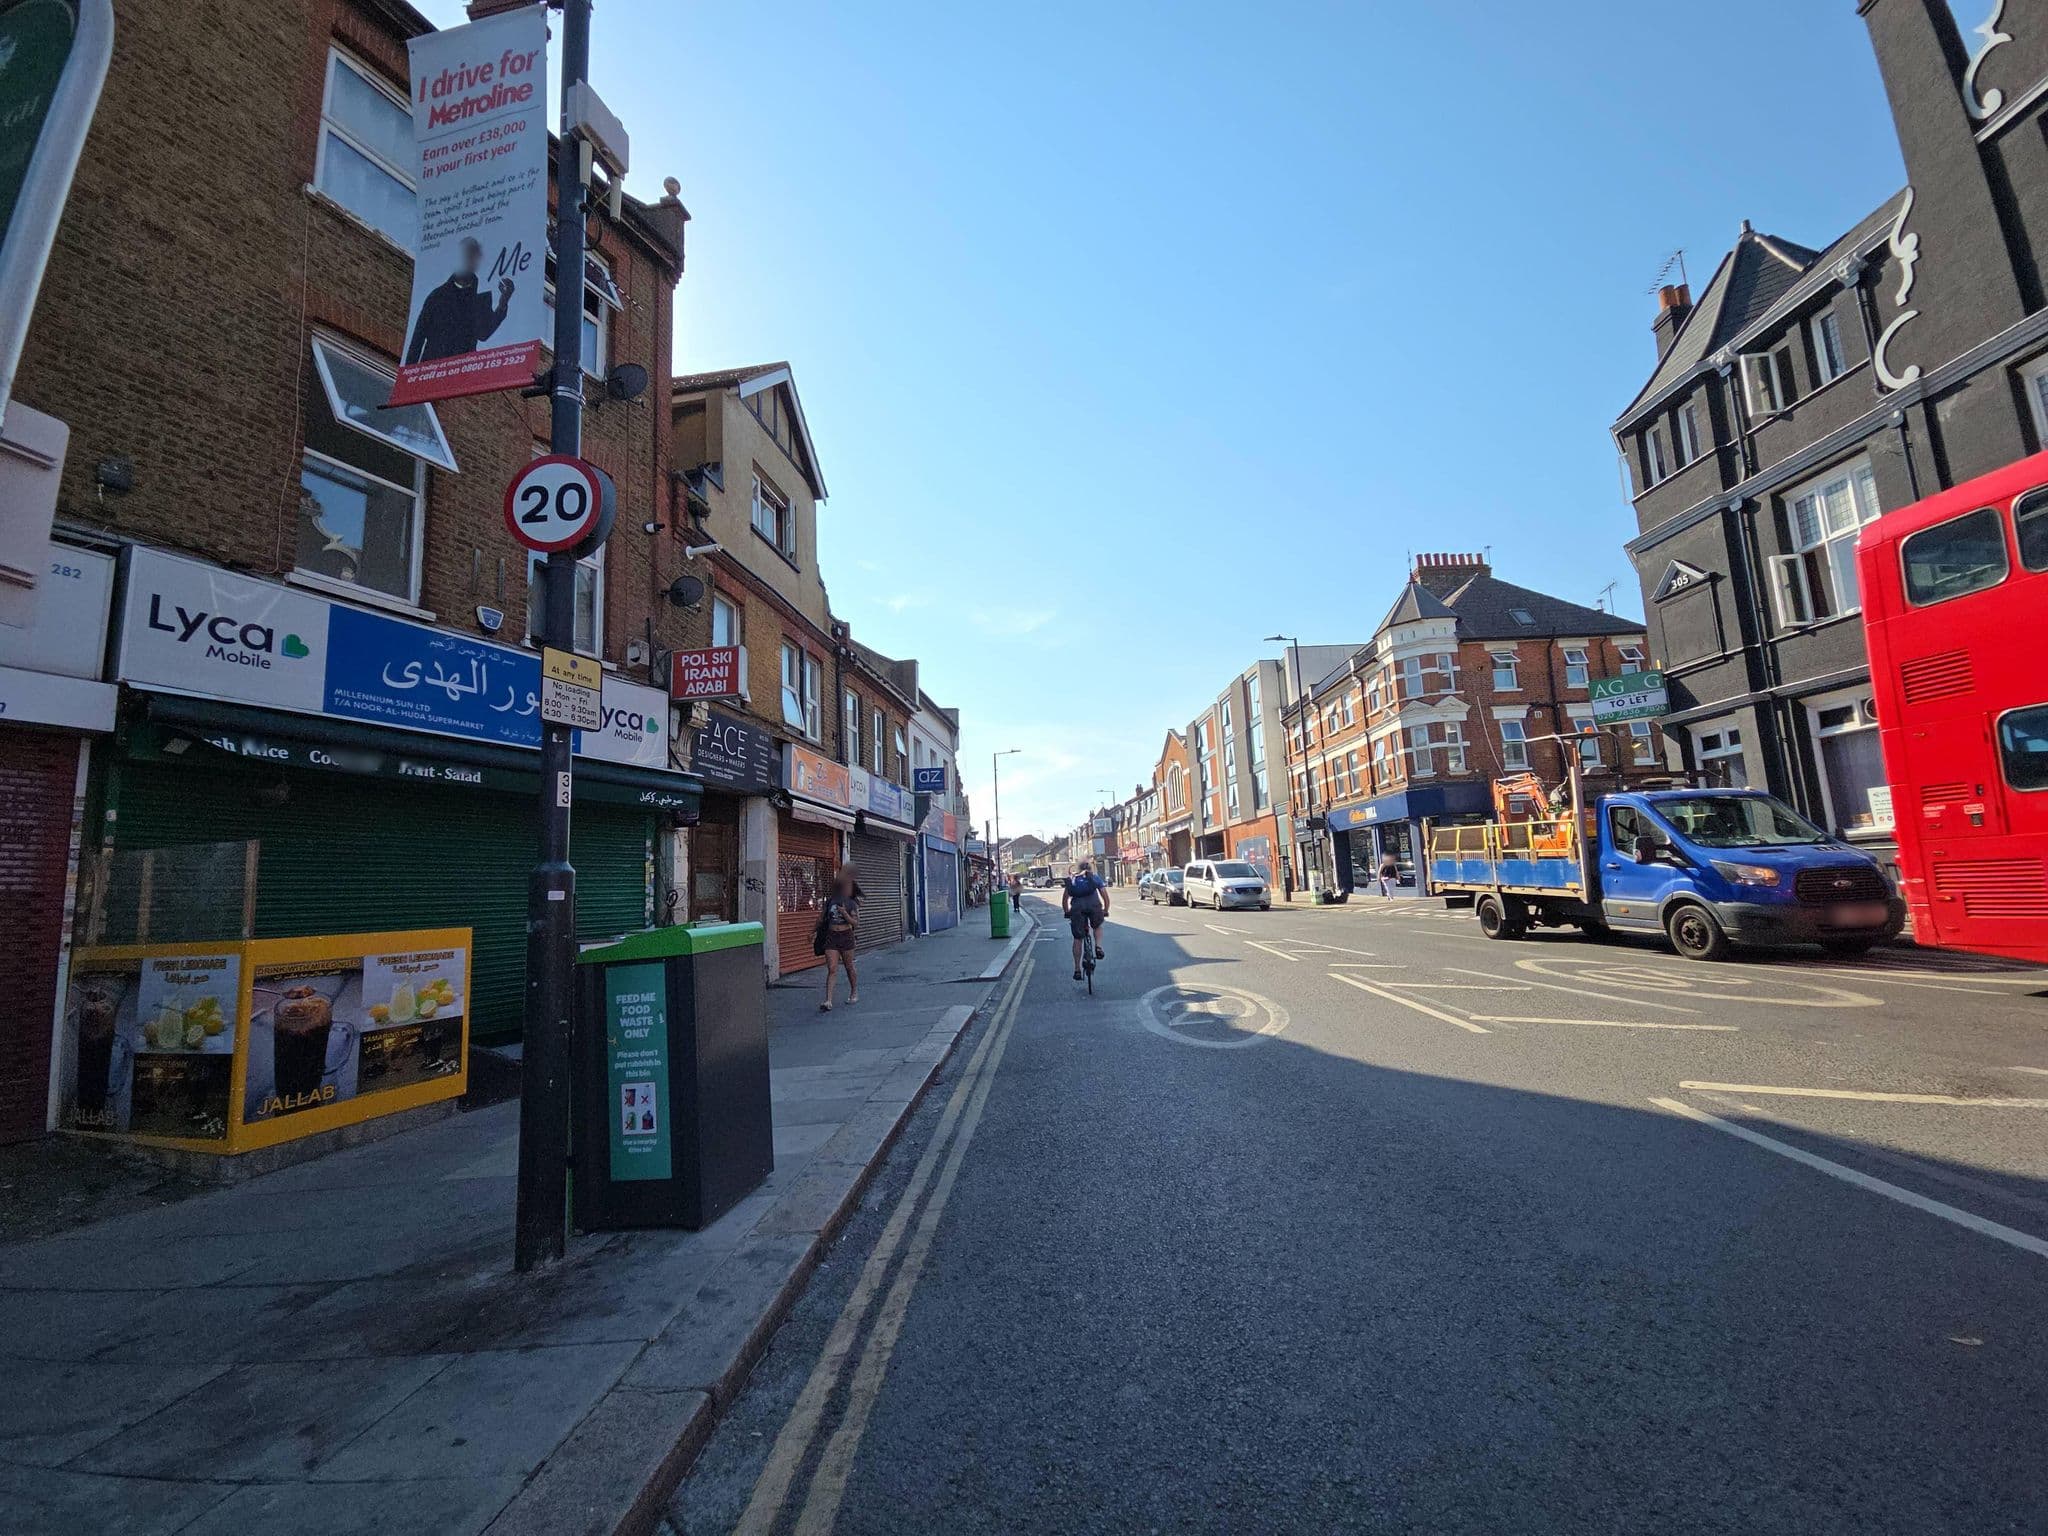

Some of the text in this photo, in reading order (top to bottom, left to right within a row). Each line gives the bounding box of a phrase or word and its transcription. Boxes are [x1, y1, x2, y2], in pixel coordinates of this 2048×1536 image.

[419, 49, 540, 102] I drive for
[428, 82, 534, 130] Metroline
[422, 120, 526, 161] Earn over £38,000
[422, 142, 518, 180] in your first year
[487, 240, 532, 282] Me
[407, 376, 418, 384] or
[418, 371, 436, 382] call
[436, 370, 446, 378] us
[448, 368, 460, 376] on
[461, 362, 484, 374] 0800
[502, 354, 526, 366] 2929
[521, 482, 587, 524] 20
[52, 564, 82, 579] 282
[1671, 574, 1688, 589] 305
[149, 594, 274, 653] Lyca
[206, 645, 272, 670] Mobile
[682, 650, 732, 667] POL SKI
[382, 658, 488, 702] الهدى
[551, 666, 592, 683] At any time
[684, 665, 729, 680] IRANI
[552, 681, 590, 698] No loading
[685, 680, 728, 694] ARABI
[334, 688, 430, 712] MILLENNIUM SUN LTD
[555, 692, 570, 702] Mon
[579, 697, 588, 706] Fri
[1610, 699, 1625, 708] TO
[1630, 695, 1648, 704] LET
[334, 698, 485, 731] T/A NOOR-AL-HUDA SUPERMARKET
[600, 706, 642, 731] yca
[614, 729, 643, 743] Mobile
[698, 749, 725, 762] DESIGNERS
[918, 770, 941, 783] az
[257, 967, 287, 976] DRINK
[616, 992, 656, 1004] FEED ME
[622, 1004, 650, 1015] FOOD
[620, 1016, 654, 1027] WASTE
[624, 1028, 650, 1038] ONLY
[258, 1085, 336, 1115] JALLAB
